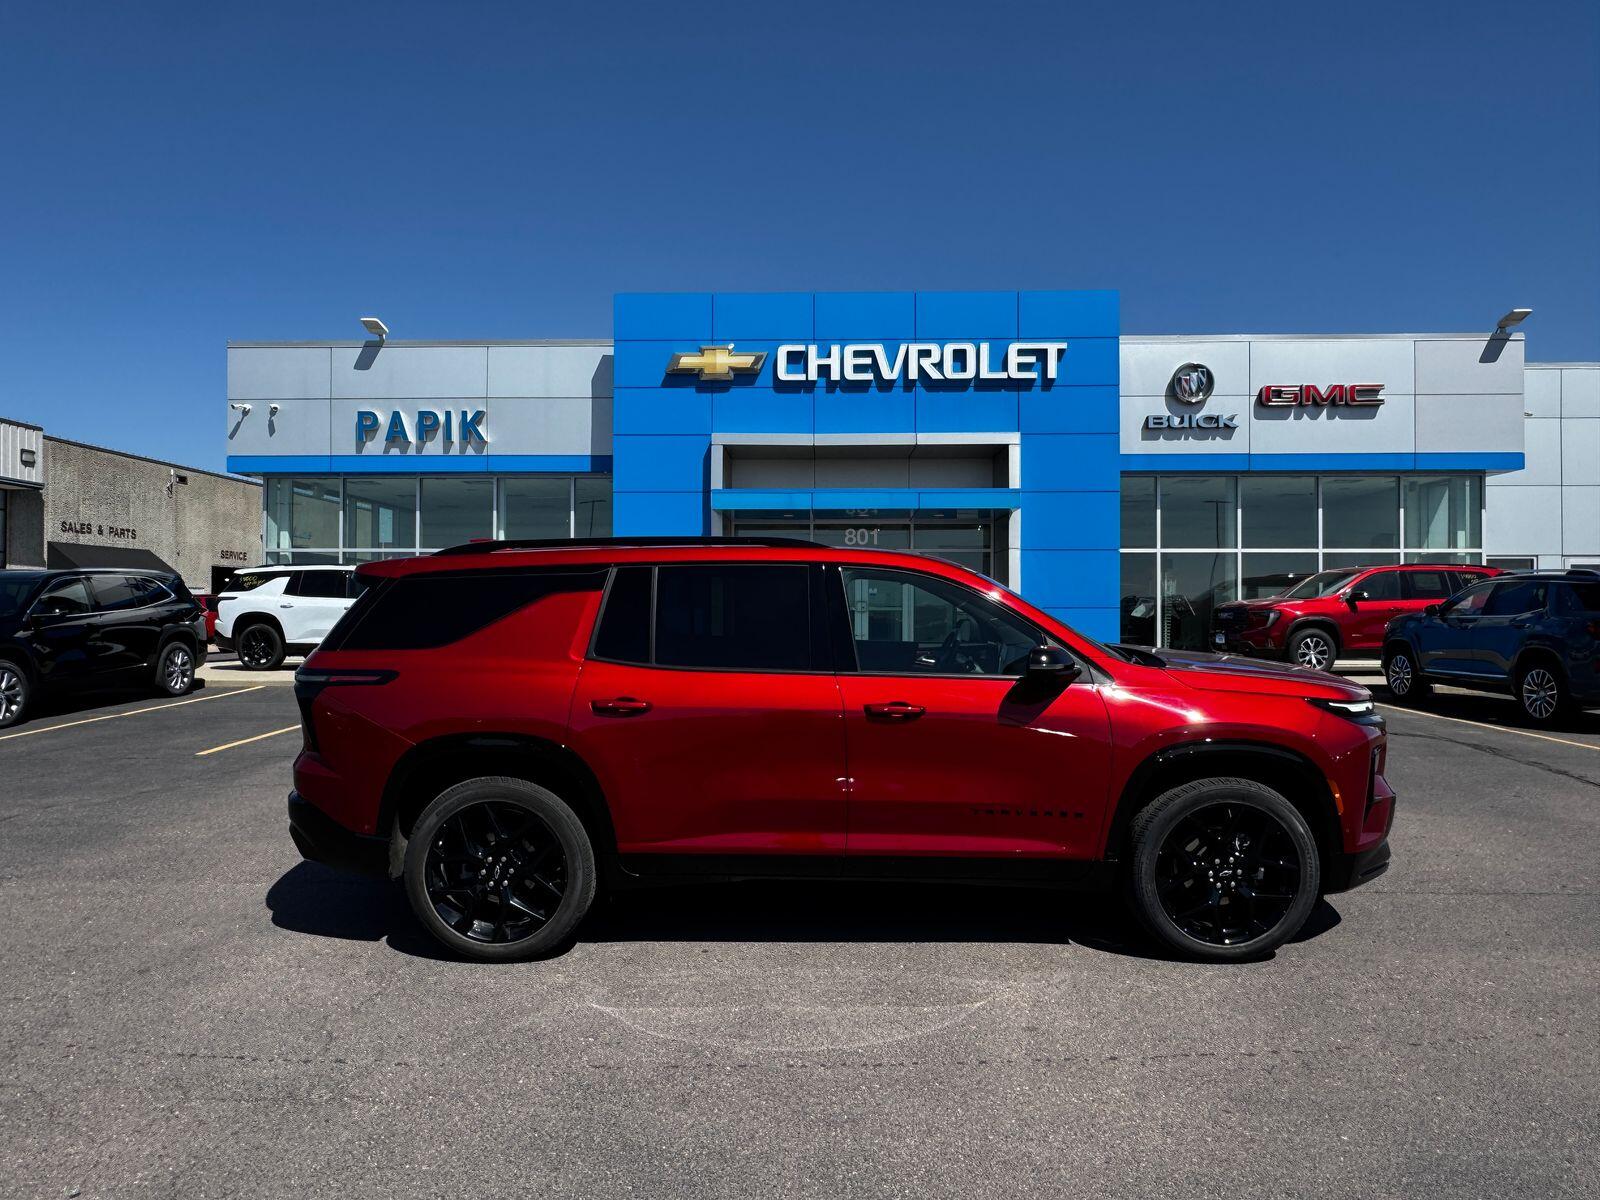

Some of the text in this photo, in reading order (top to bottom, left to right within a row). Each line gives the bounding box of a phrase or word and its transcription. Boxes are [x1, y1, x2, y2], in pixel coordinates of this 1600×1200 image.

[776, 342, 1068, 381] CHEVROLET
[1261, 383, 1386, 406] GMC
[357, 410, 487, 442] PAPIK
[1147, 413, 1239, 429] BUICK
[60, 521, 137, 540] SALES & PARTS
[844, 528, 878, 546] 801
[220, 550, 248, 561] SERVICE
